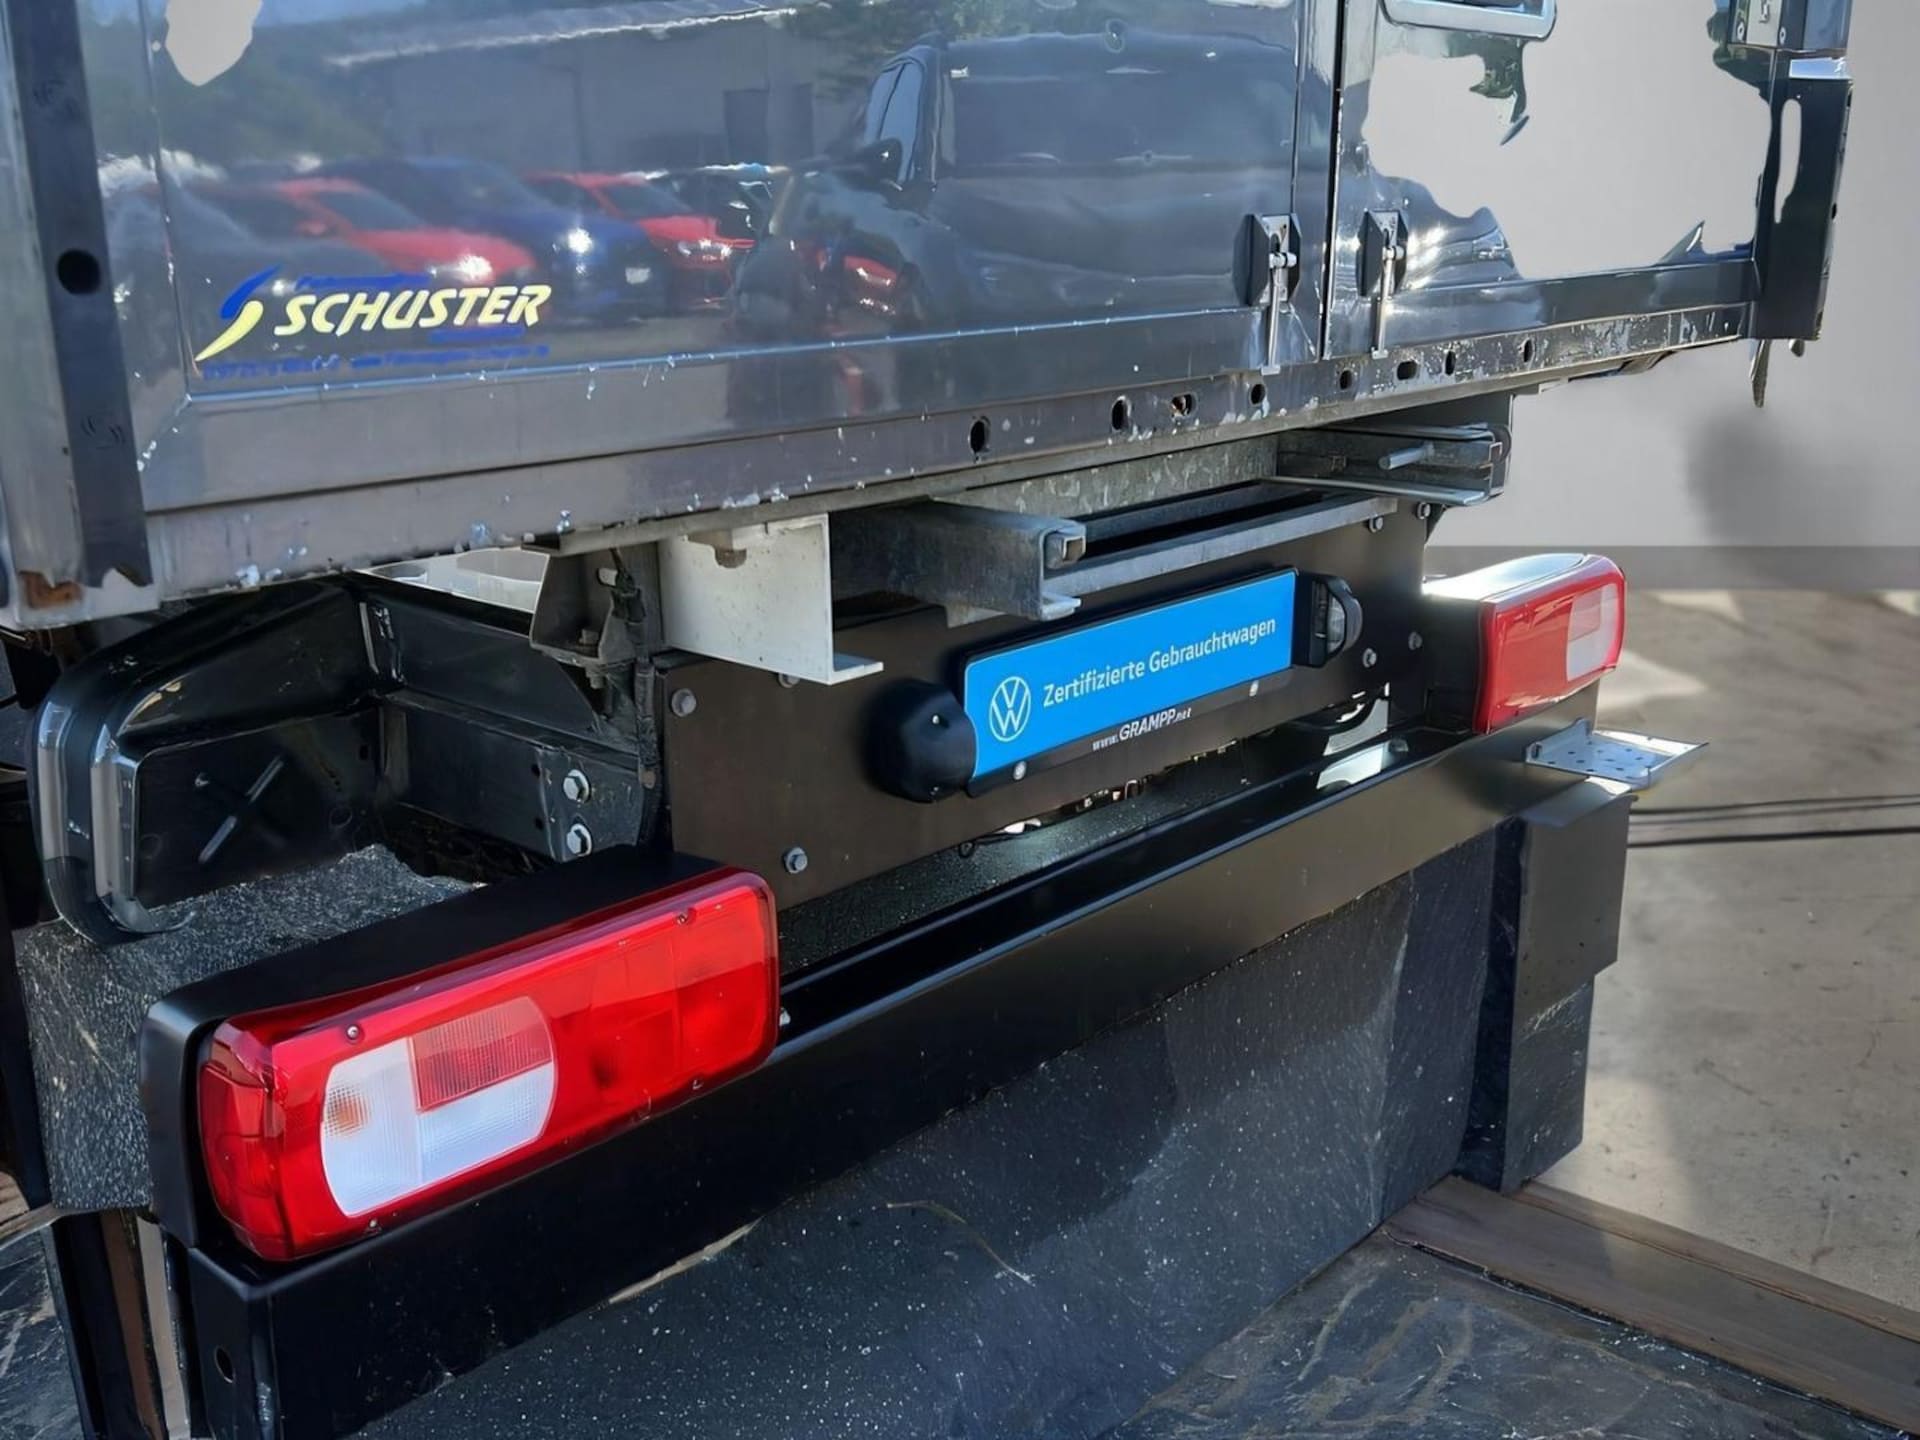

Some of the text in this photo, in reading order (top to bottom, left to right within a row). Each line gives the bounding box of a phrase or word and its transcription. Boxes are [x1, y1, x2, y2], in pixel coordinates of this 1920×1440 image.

[274, 285, 552, 336] SCHUSTER
[1043, 618, 1276, 707] Zertifizierte Gebrauchtwagen
